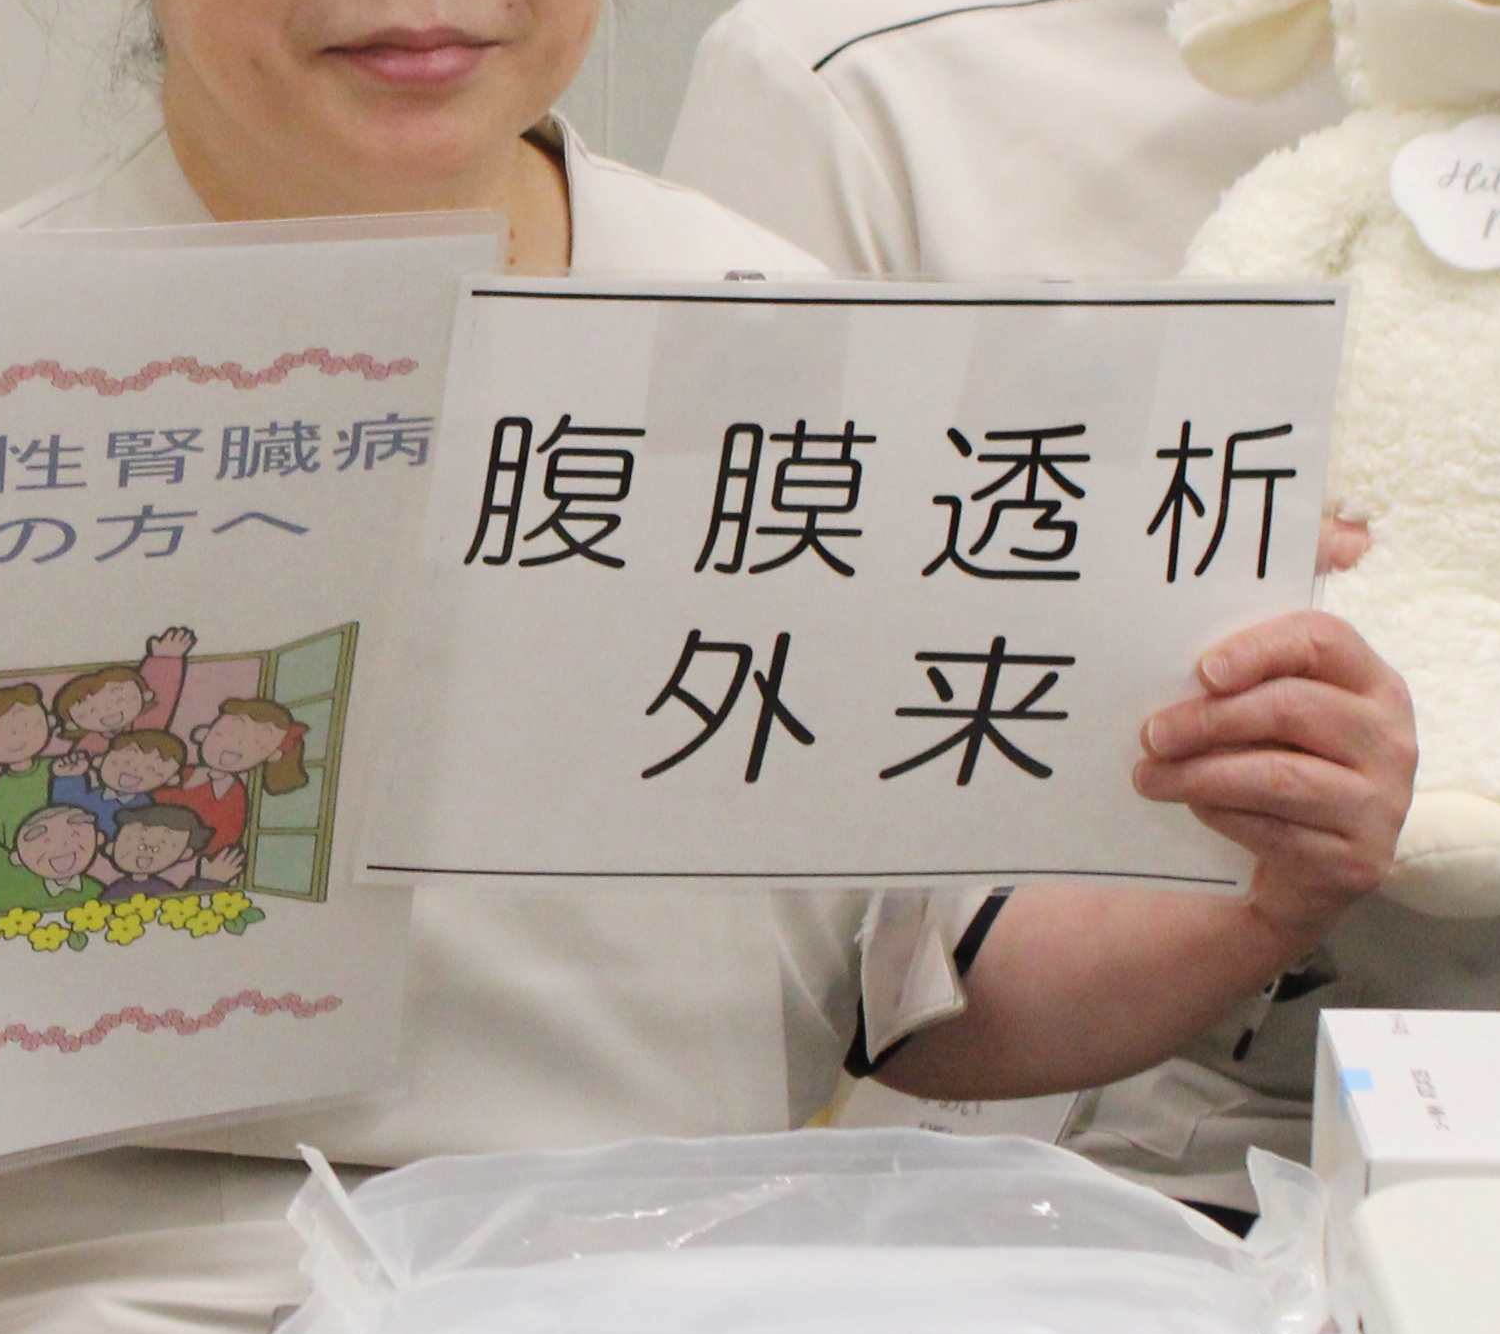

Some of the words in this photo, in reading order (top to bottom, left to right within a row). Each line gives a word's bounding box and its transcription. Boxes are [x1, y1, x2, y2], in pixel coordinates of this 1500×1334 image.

[463, 413, 1298, 584] 腹膜透析
[641, 629, 1075, 786] 外来
